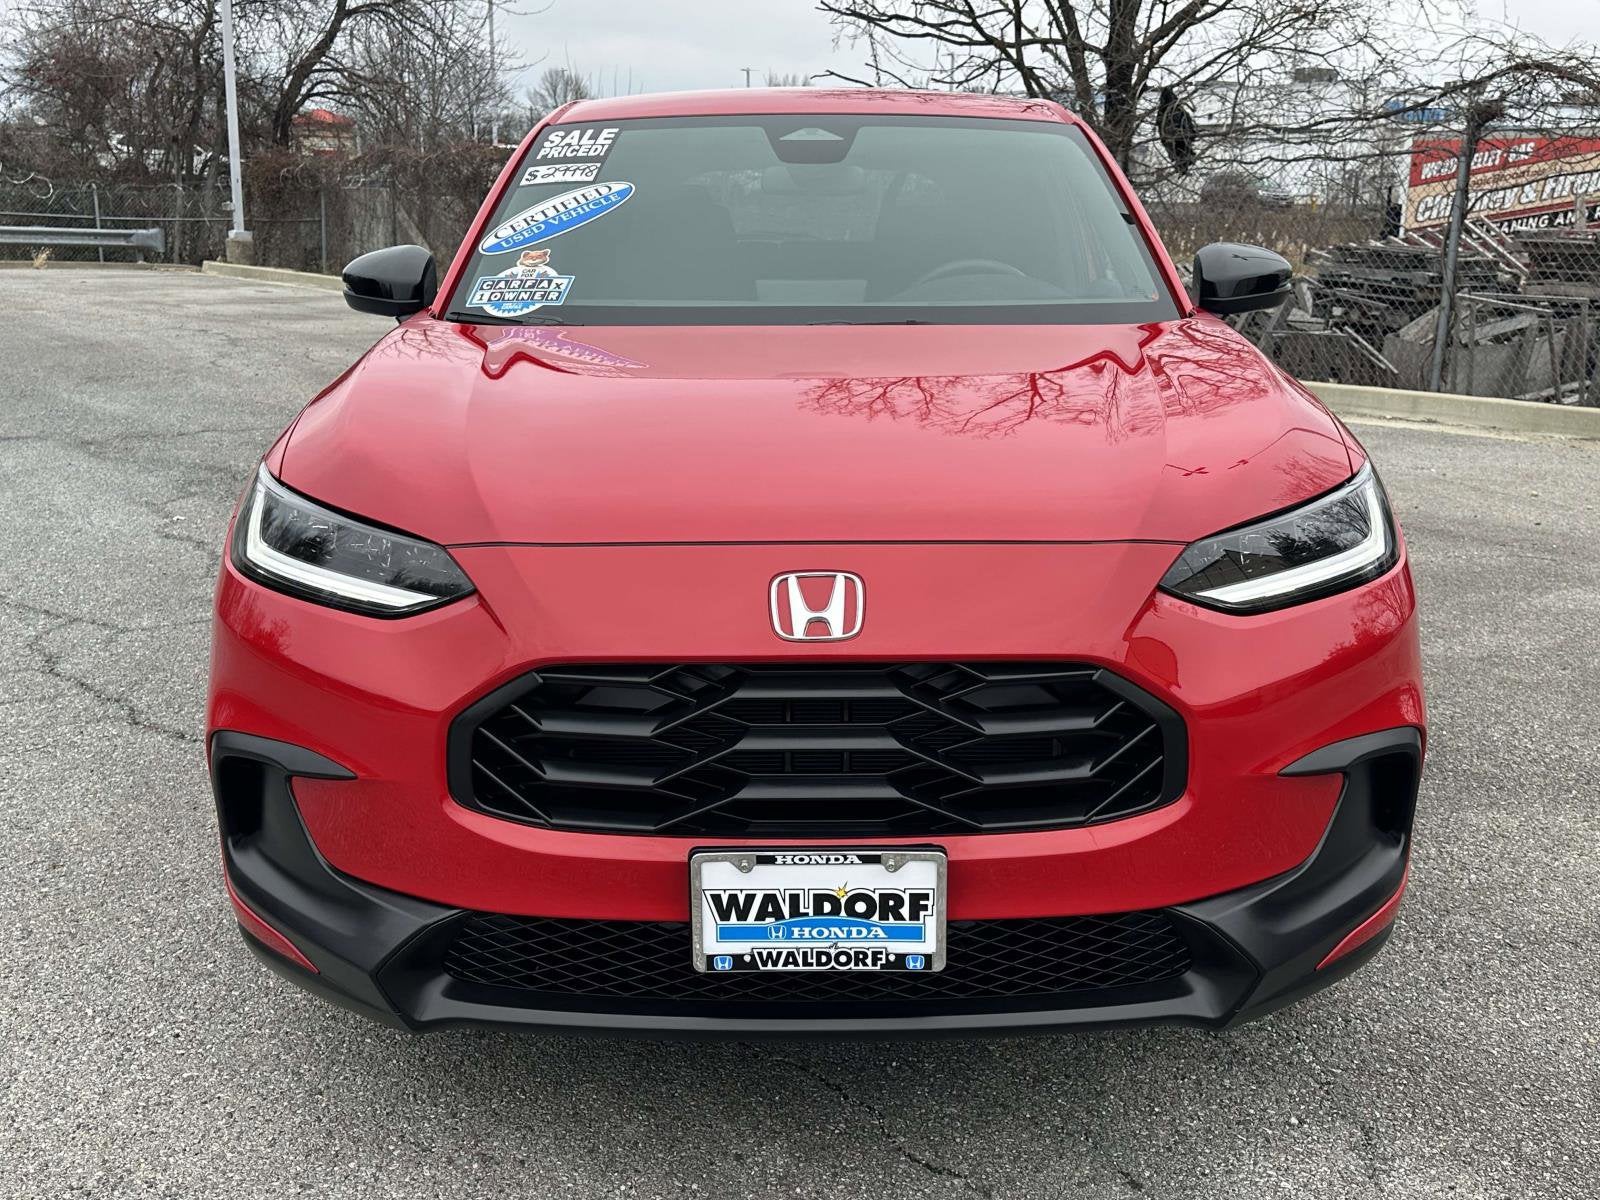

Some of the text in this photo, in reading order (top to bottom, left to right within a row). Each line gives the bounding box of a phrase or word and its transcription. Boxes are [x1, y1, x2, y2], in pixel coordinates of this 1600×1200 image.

[543, 128, 619, 147] SALE
[536, 144, 609, 160] PRICED!
[493, 184, 613, 241] CERTIFIED
[501, 193, 622, 249] USED VEHICLE
[1553, 207, 1589, 226] AN
[481, 279, 564, 290] CARFAX
[490, 291, 559, 301] OWNER
[774, 855, 862, 865] HONDA
[707, 890, 932, 922] WALDORF
[791, 927, 888, 939] HONDA
[754, 949, 886, 970] WALDORF
